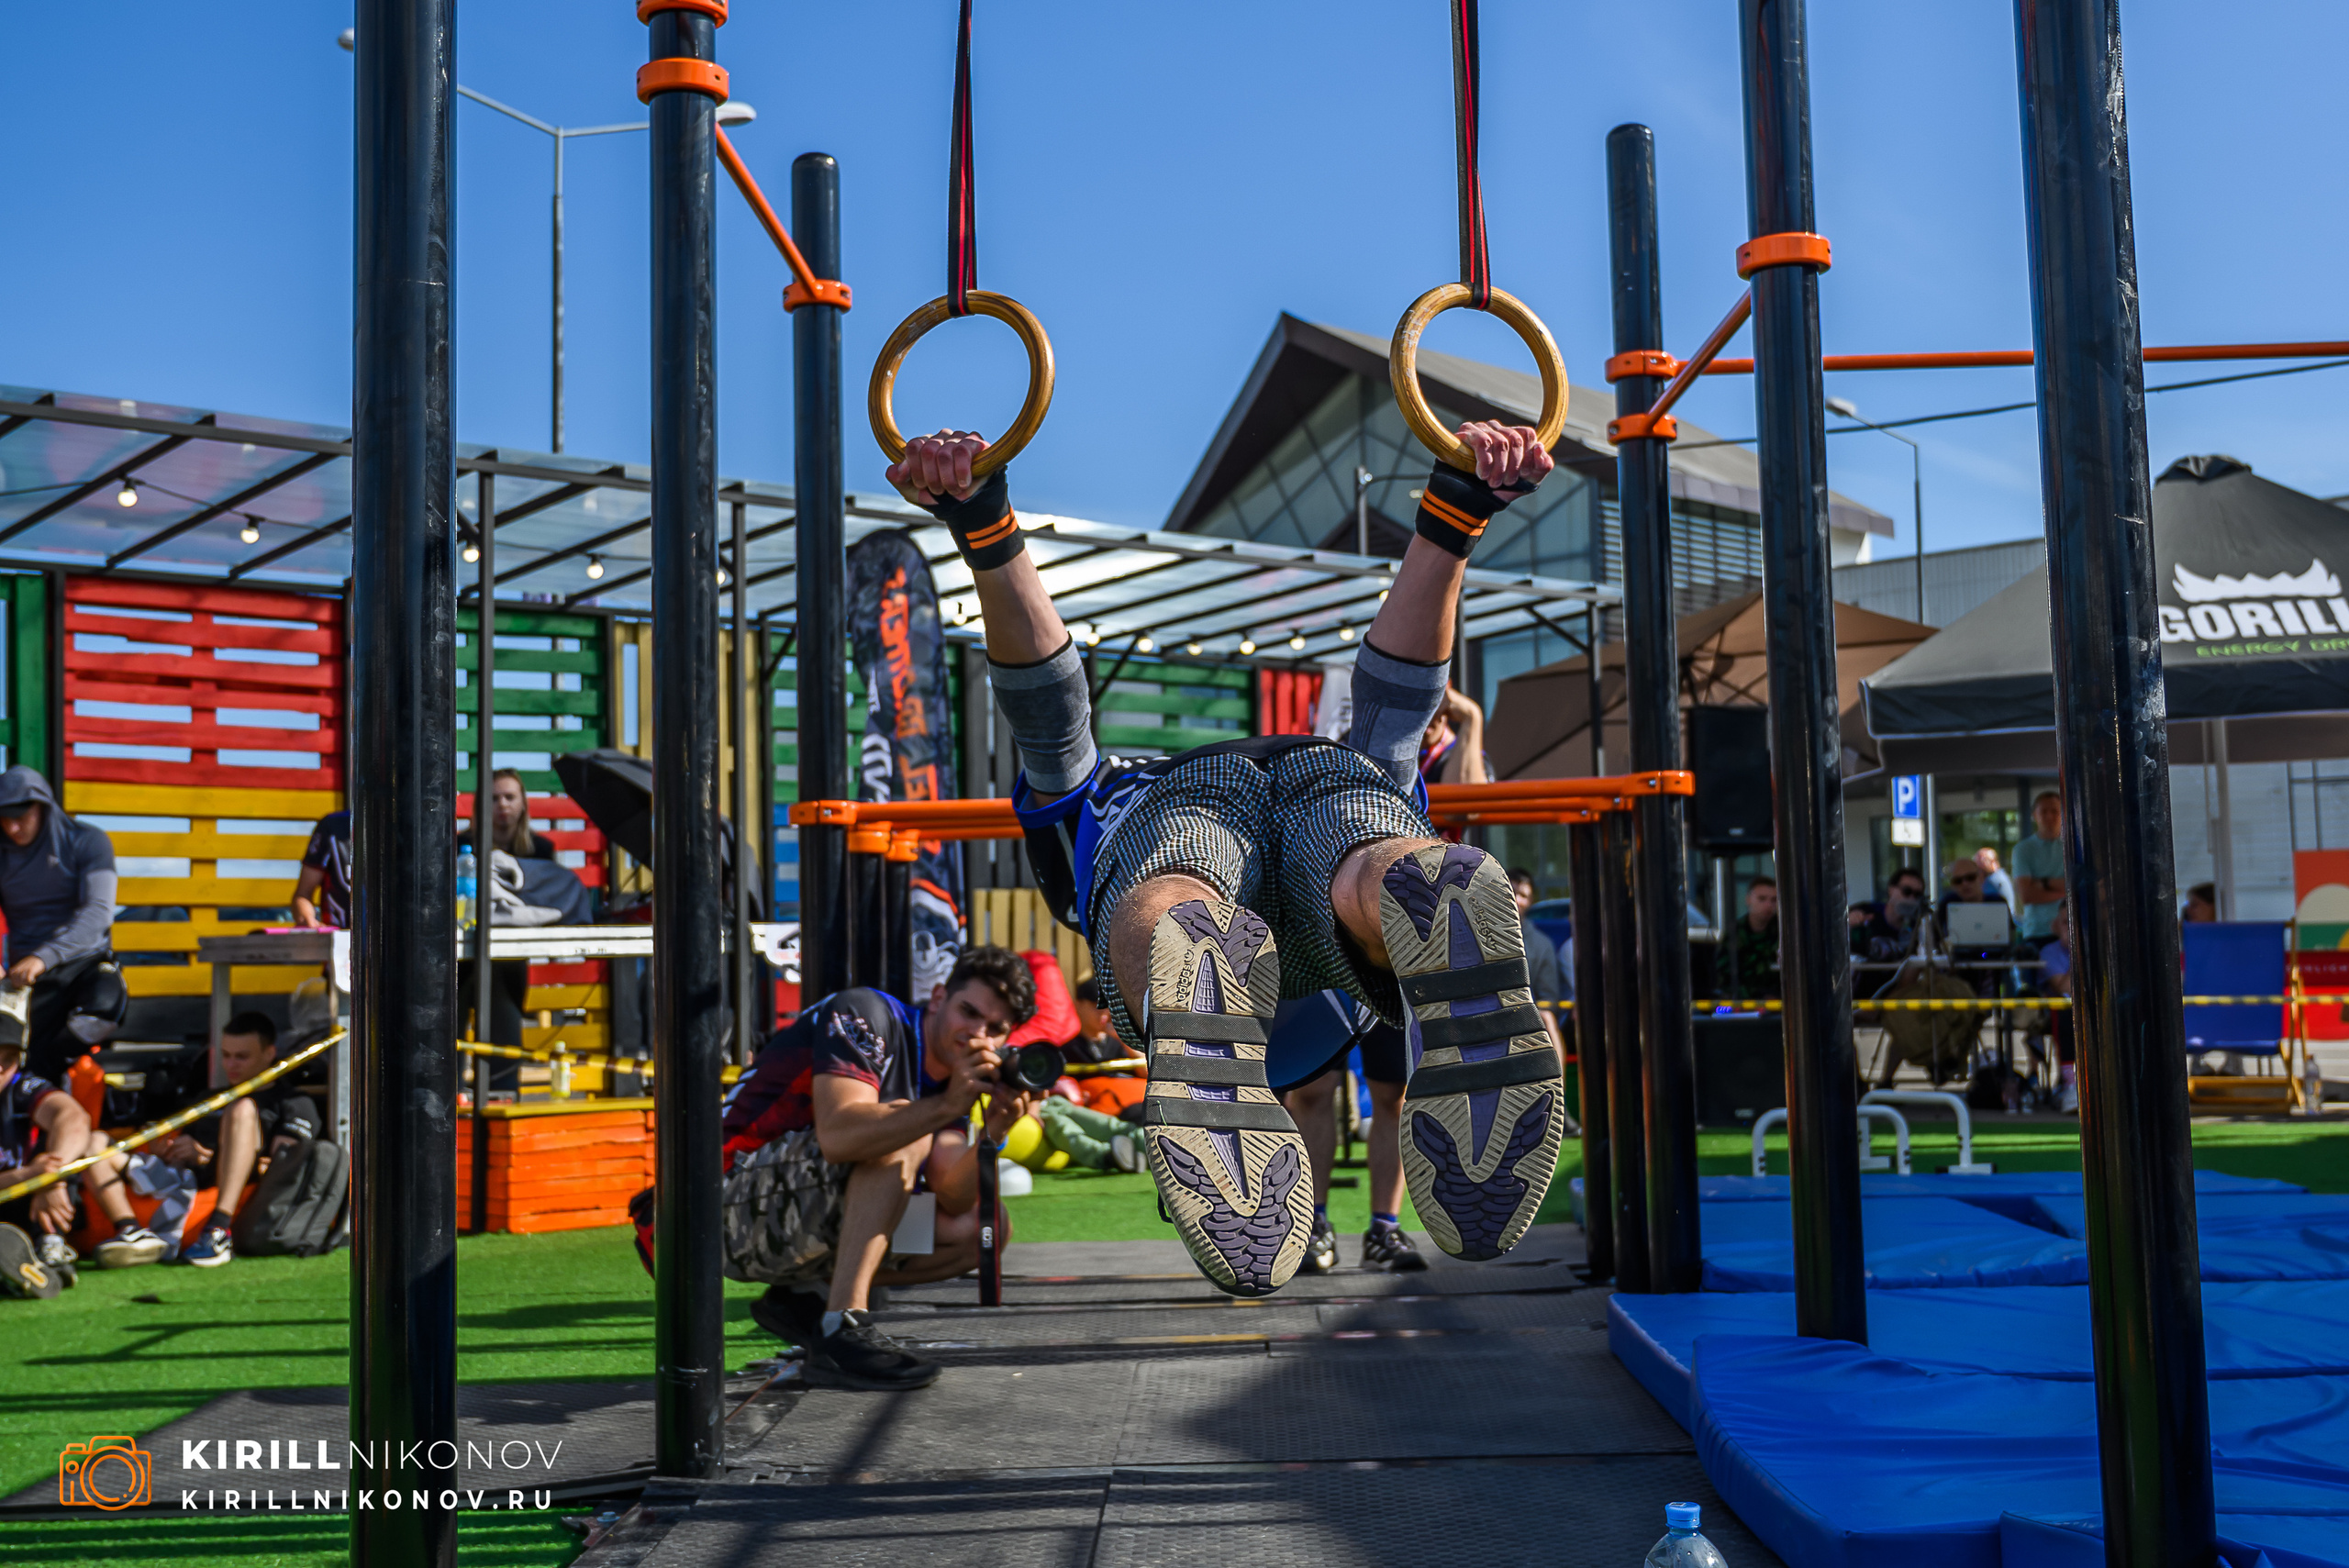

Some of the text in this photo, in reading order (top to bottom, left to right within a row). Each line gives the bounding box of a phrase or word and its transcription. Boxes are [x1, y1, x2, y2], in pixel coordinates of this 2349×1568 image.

[2196, 638, 2349, 659] ENERGY DR
[1897, 776, 1916, 814] P
[1468, 896, 1490, 936] adidas
[1176, 963, 1192, 1002] adidas
